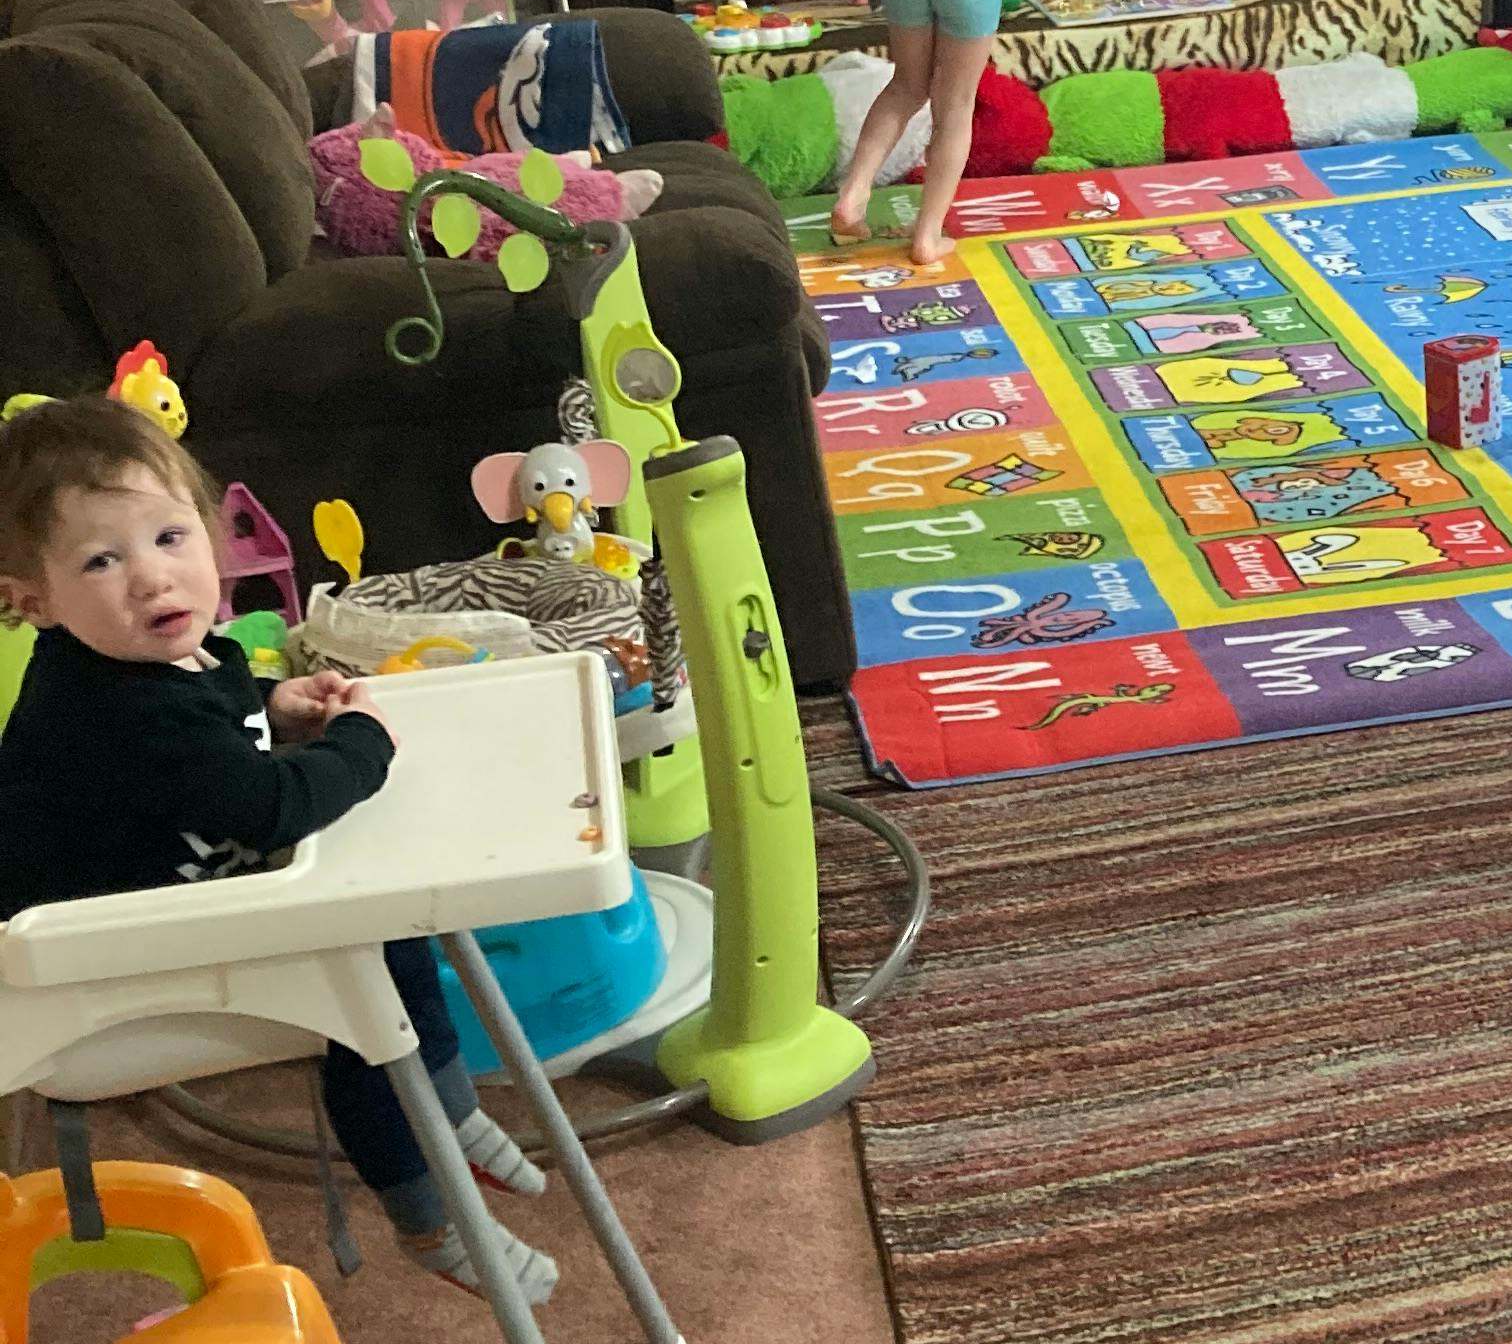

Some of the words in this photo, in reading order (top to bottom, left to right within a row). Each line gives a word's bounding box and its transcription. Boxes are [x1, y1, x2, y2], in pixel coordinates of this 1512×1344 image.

[1049, 281, 1095, 313] Monday
[1237, 280, 1267, 291] 2
[1258, 306, 1294, 324] Day
[1274, 322, 1307, 332] 3
[1383, 296, 1438, 327] Rainy
[1077, 320, 1127, 358] Tuesday
[1296, 353, 1333, 371] Day
[1316, 369, 1348, 381] 4
[987, 375, 1032, 404] robot
[1344, 404, 1383, 422] Day
[1006, 431, 1067, 458] quilt
[1140, 415, 1203, 469] Thursday
[1363, 424, 1400, 436] 5
[1410, 476, 1448, 488] 6
[1183, 483, 1239, 515] Friday
[1443, 519, 1487, 545] Day
[1465, 545, 1505, 555] 7
[1223, 539, 1294, 594] Saturday
[1086, 561, 1142, 613] octopus
[1393, 608, 1457, 637] milk
[1130, 642, 1184, 677] newt
[1223, 626, 1368, 697] Mm
[918, 661, 1063, 724] Nn
